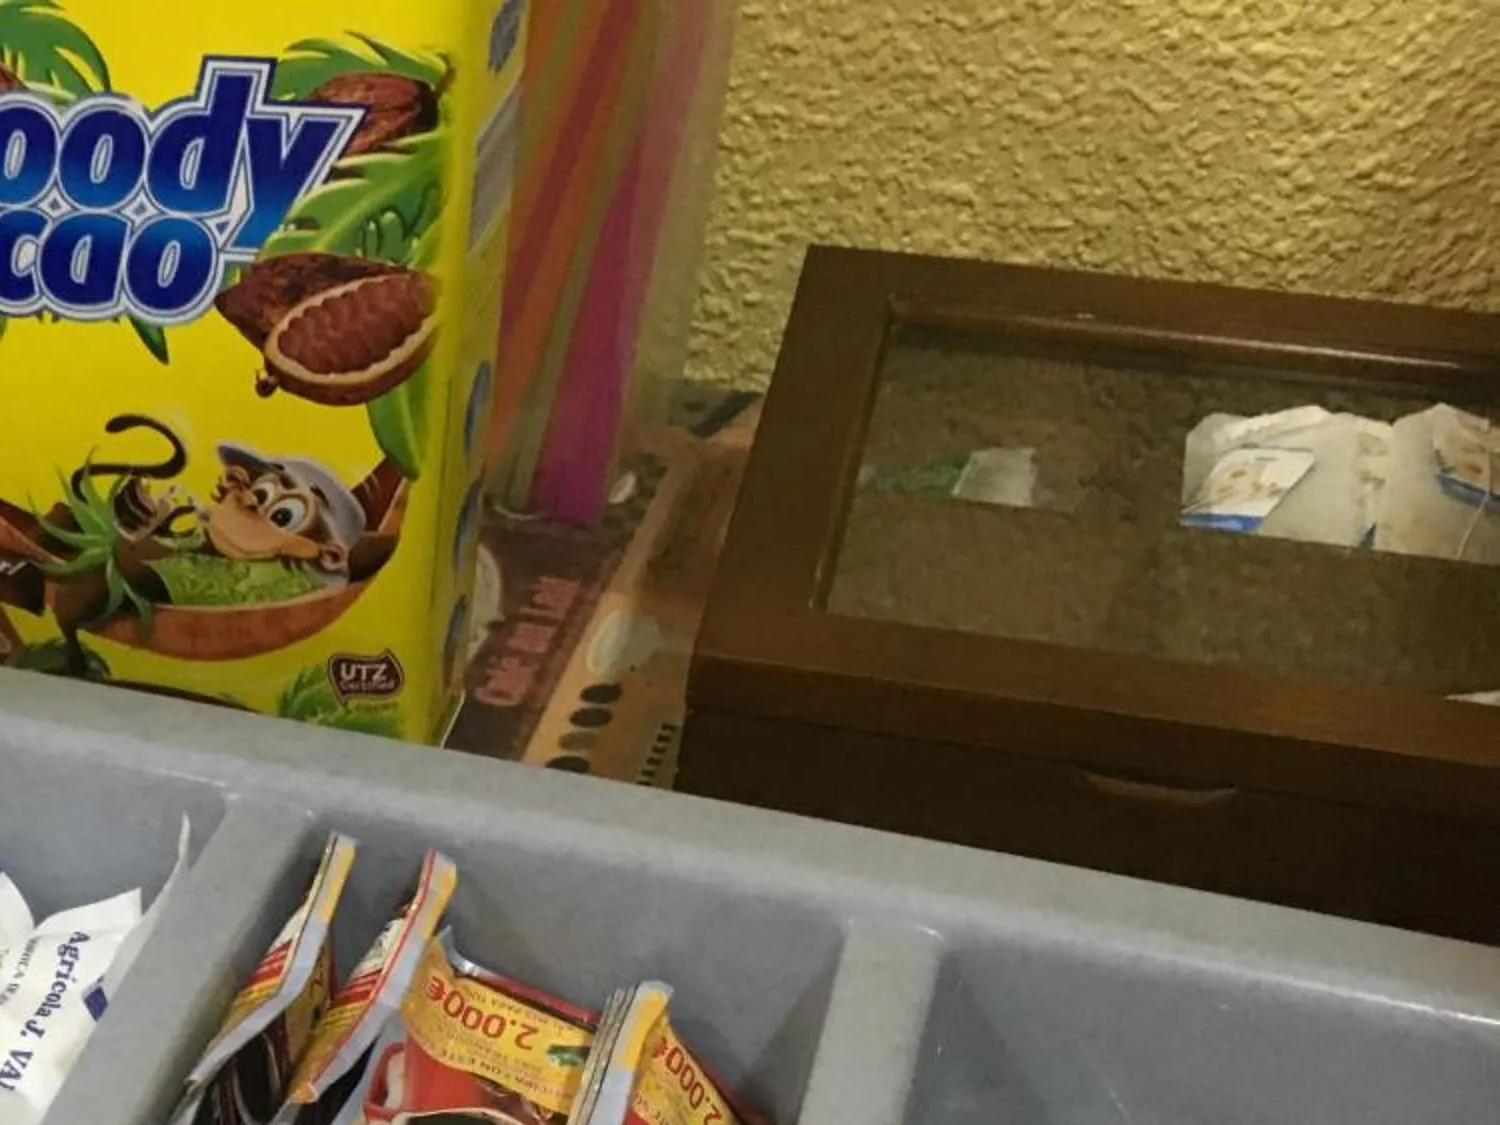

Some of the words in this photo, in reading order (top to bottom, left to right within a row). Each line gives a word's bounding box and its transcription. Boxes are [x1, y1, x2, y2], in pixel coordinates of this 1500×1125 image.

[340, 663, 388, 682] UTZ
[35, 932, 89, 1016] Agricola
[20, 1019, 44, 1037] J.
[425, 975, 539, 1050] 2.000€
